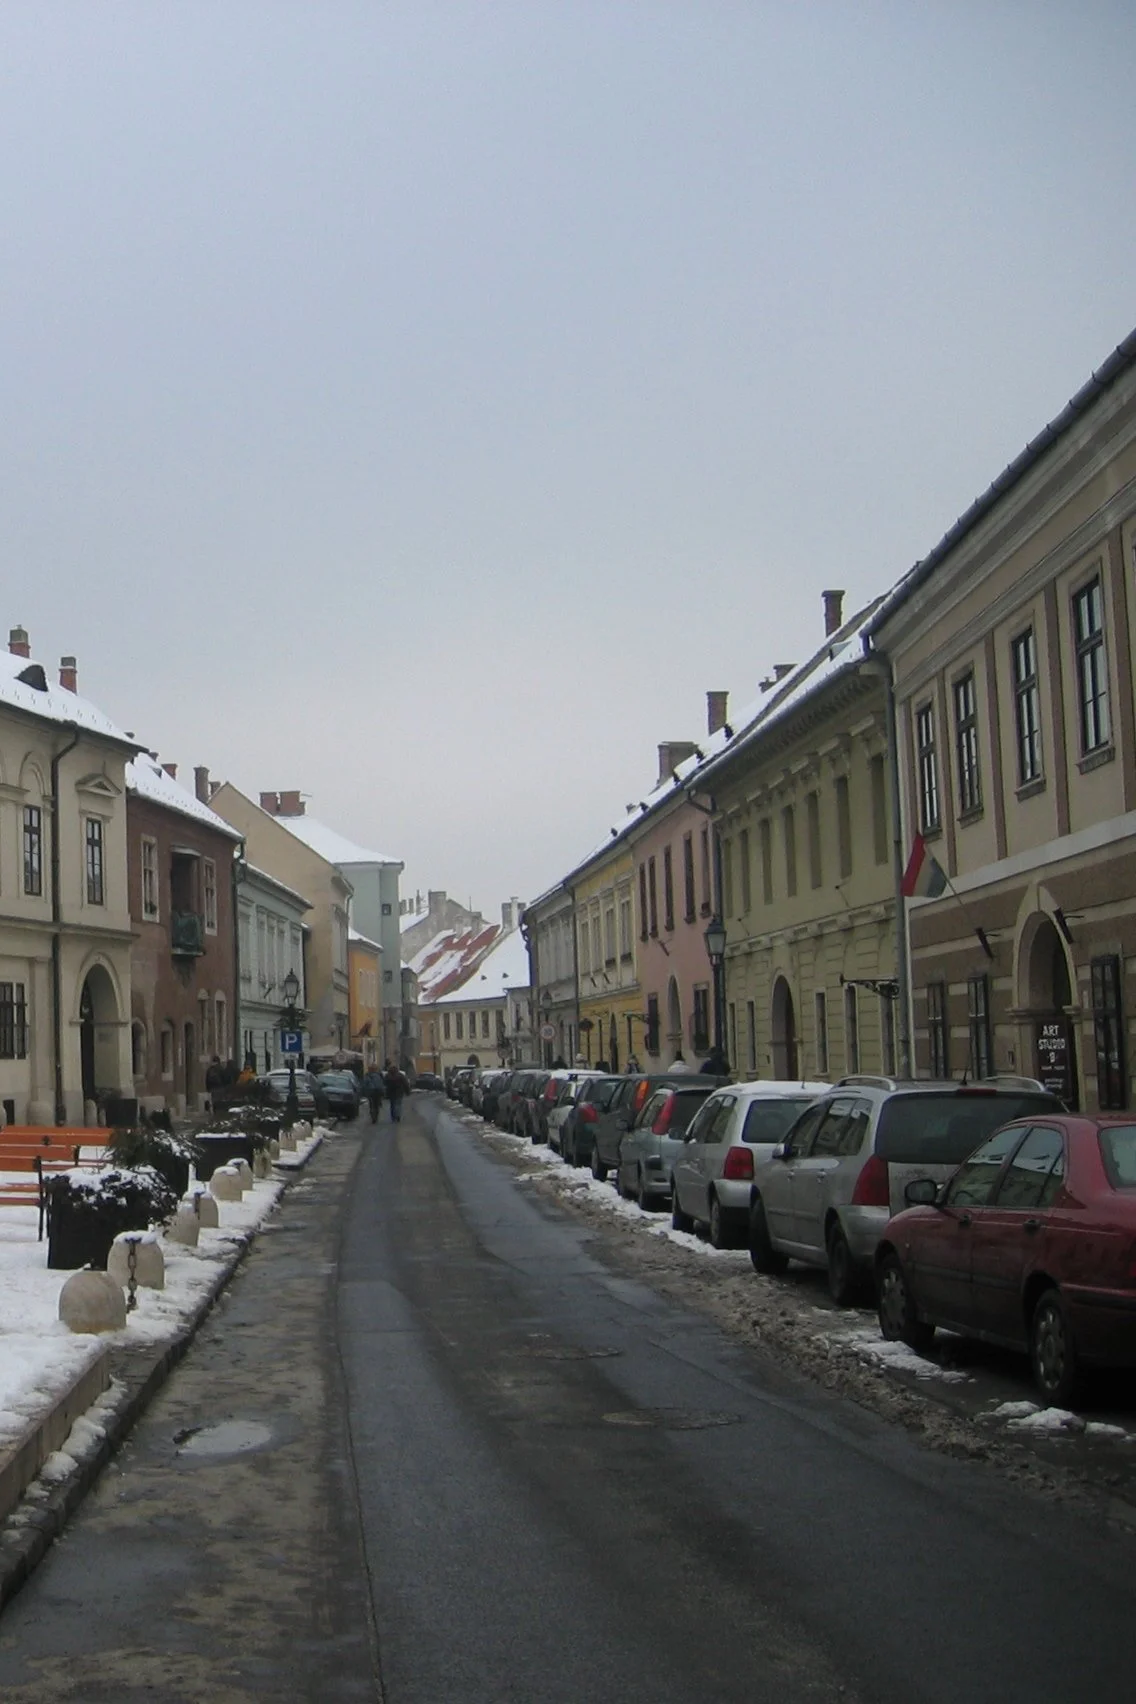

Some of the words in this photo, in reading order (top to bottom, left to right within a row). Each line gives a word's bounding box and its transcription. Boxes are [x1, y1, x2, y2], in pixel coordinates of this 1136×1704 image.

[1043, 1025, 1059, 1036] ART
[285, 1033, 298, 1050] P
[1038, 1038, 1066, 1050] STUDIO
